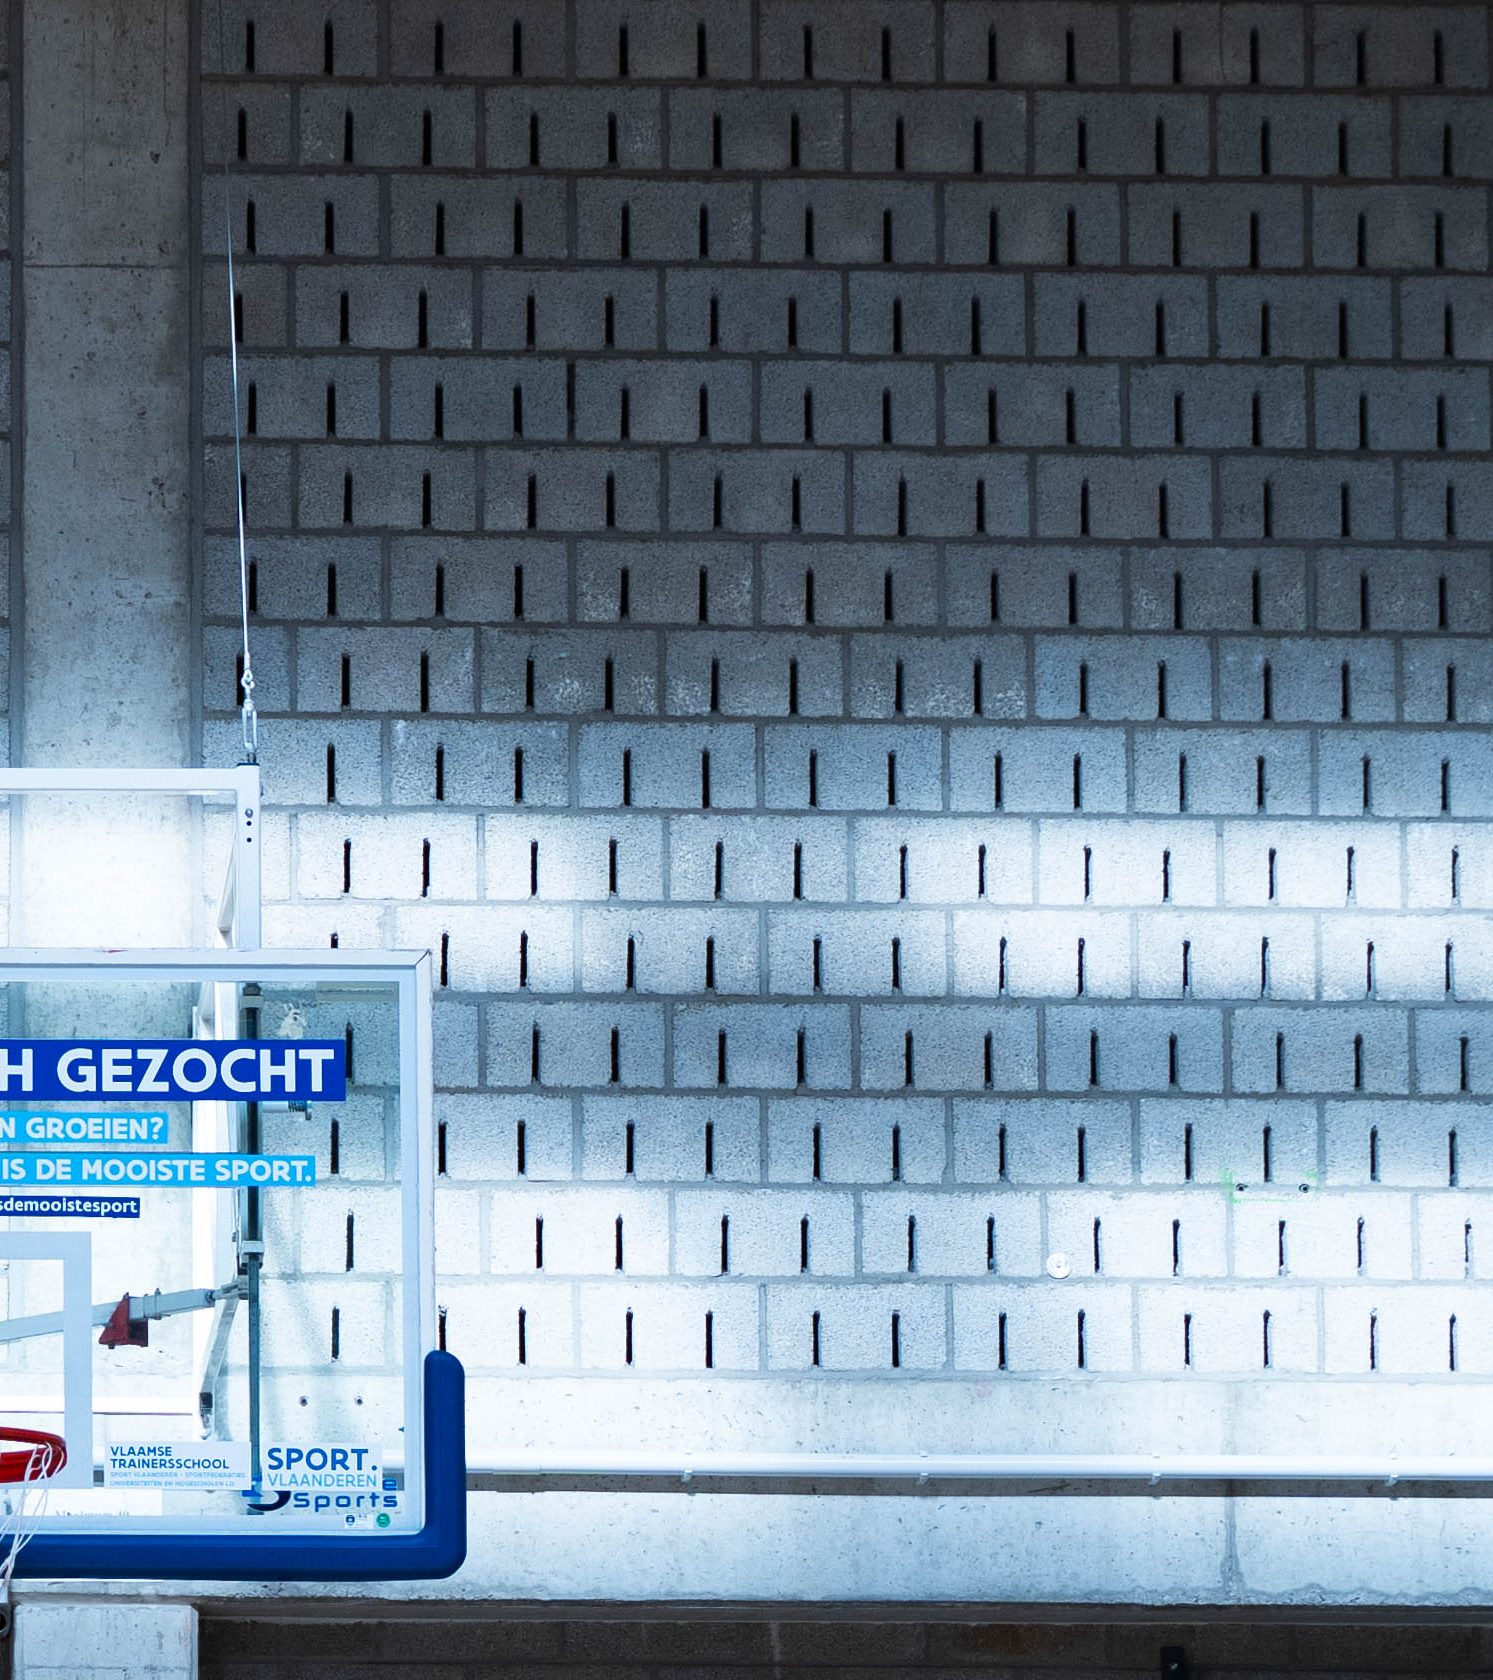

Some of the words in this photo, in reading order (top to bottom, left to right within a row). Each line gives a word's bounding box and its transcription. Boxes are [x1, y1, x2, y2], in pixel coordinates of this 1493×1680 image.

[56, 1047, 335, 1093] GEZOCHT
[25, 1116, 164, 1140] GROEIEN?
[2, 1158, 26, 1180] IS
[36, 1158, 74, 1181] DE
[81, 1158, 206, 1182] MOOISTE
[214, 1159, 313, 1182] SPORT.
[110, 1446, 172, 1457] VLAAMSE
[267, 1447, 378, 1471] SPORT.
[110, 1458, 230, 1470] TRAINERSSCHOOL
[267, 1473, 377, 1487] VLAANDEREN
[293, 1492, 398, 1512] Sports
